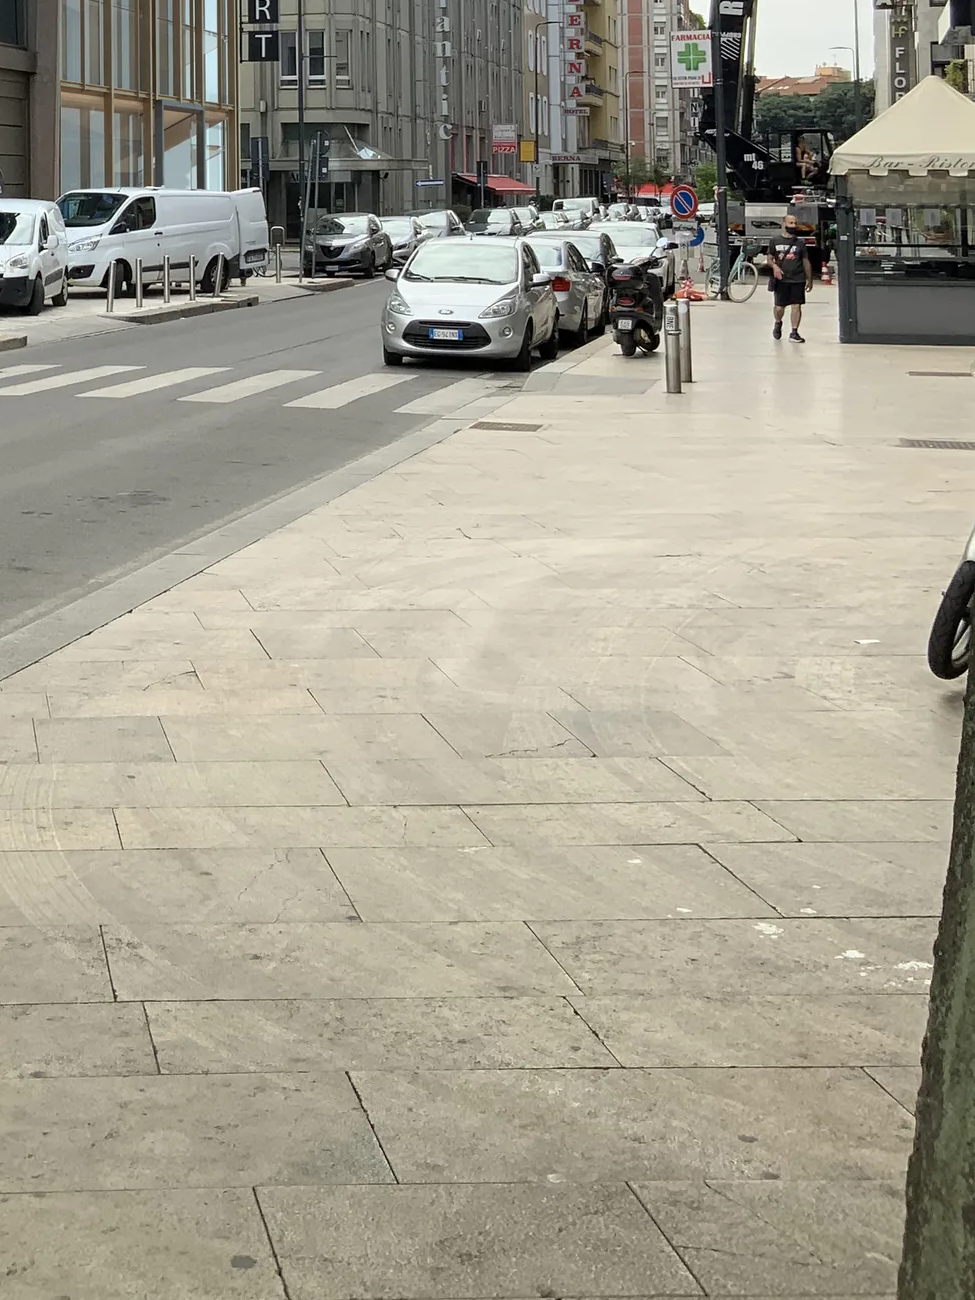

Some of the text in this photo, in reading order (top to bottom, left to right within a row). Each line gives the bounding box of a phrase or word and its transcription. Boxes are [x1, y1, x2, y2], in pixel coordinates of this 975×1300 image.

[671, 33, 711, 41] FARMACIA
[751, 160, 764, 170] 46
[862, 155, 904, 168] Bar
